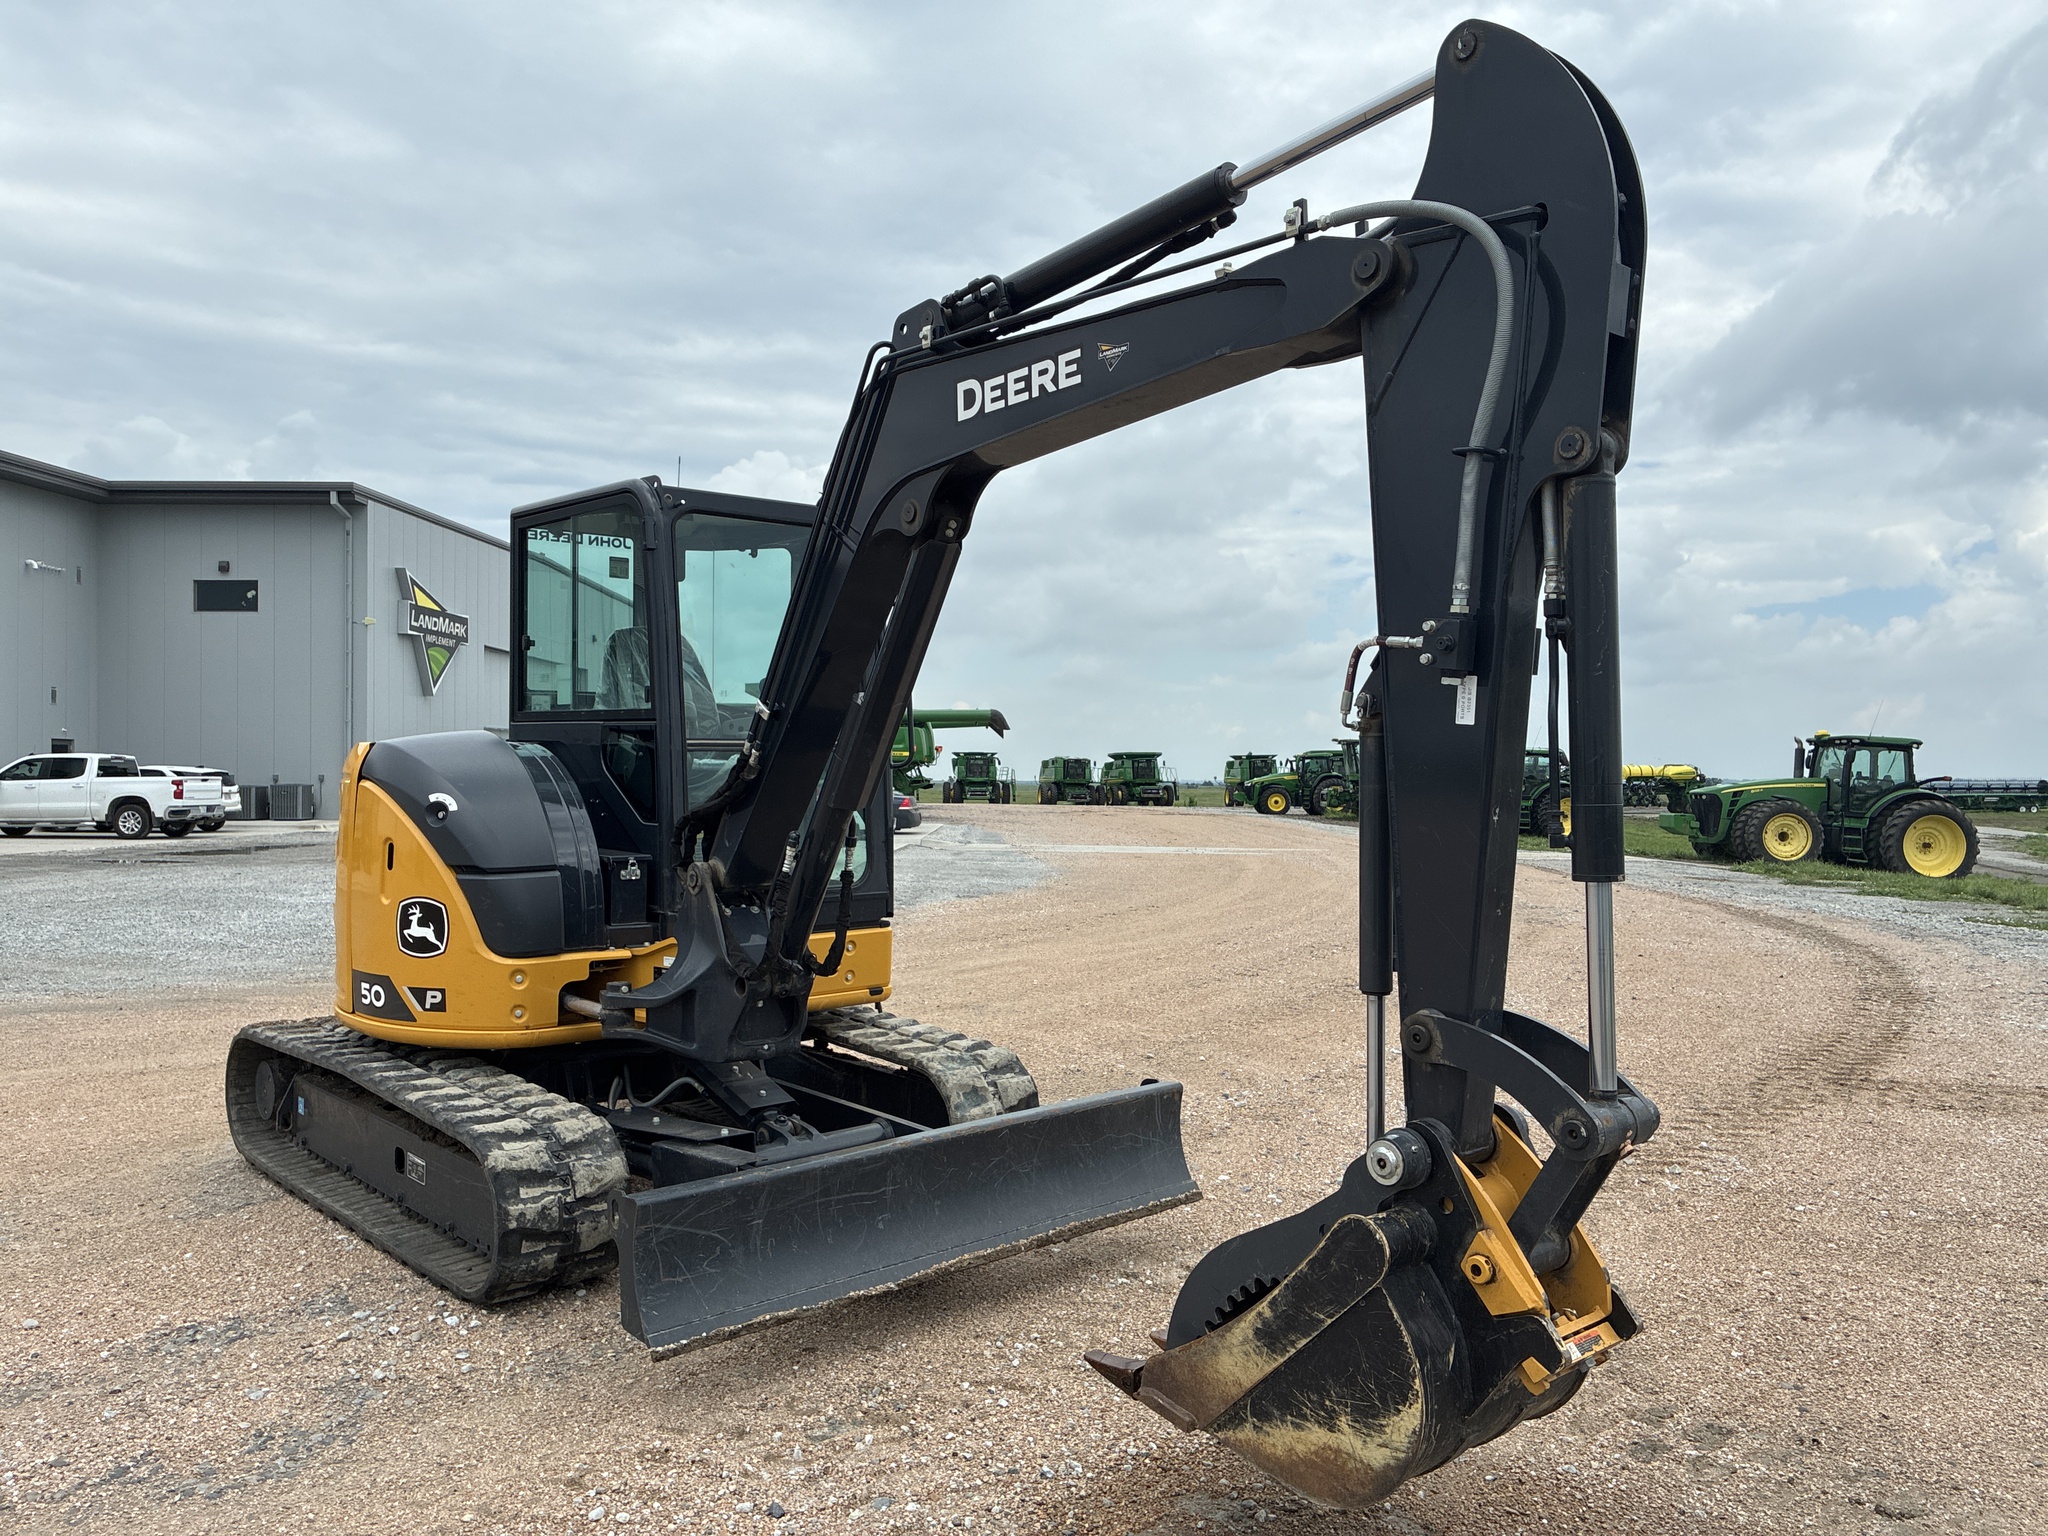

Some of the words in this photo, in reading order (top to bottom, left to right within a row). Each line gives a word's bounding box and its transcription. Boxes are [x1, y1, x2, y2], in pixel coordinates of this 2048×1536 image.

[957, 348, 1082, 422] DEERE
[425, 634, 456, 648] IMPLEMENT
[360, 982, 385, 1008] 50
[425, 991, 442, 1009] P
